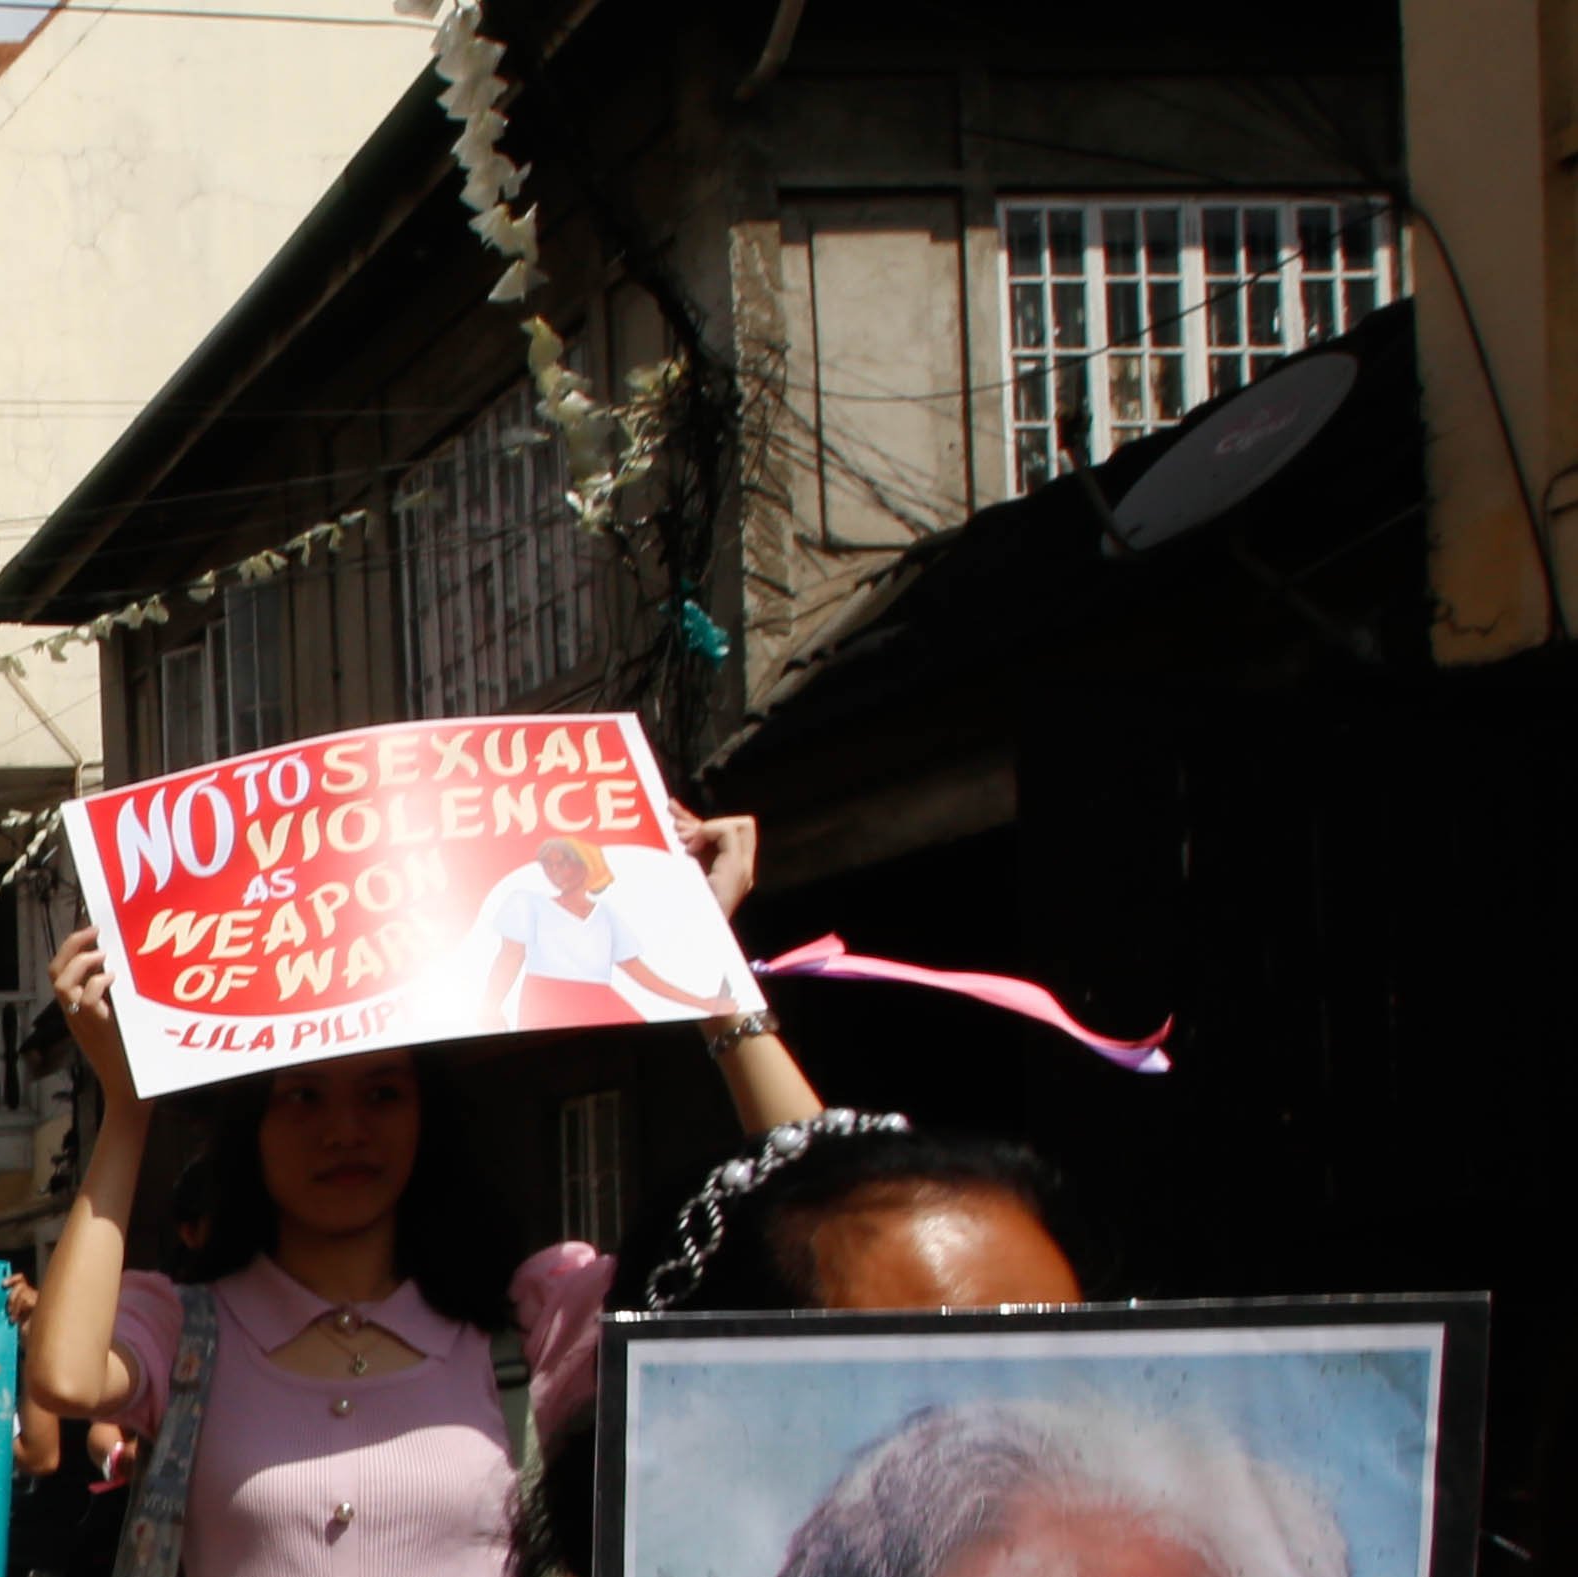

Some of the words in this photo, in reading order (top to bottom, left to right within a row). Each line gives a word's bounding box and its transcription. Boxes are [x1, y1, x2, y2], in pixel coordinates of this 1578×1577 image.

[116, 771, 235, 902] NO
[233, 752, 310, 816] TO
[321, 727, 629, 794] SEXUAL
[247, 780, 641, 870] VIOLENCE
[138, 845, 448, 960] WEAPON
[242, 867, 297, 905] AS
[173, 964, 258, 1004] OF
[290, 1000, 403, 1050] PILIP
